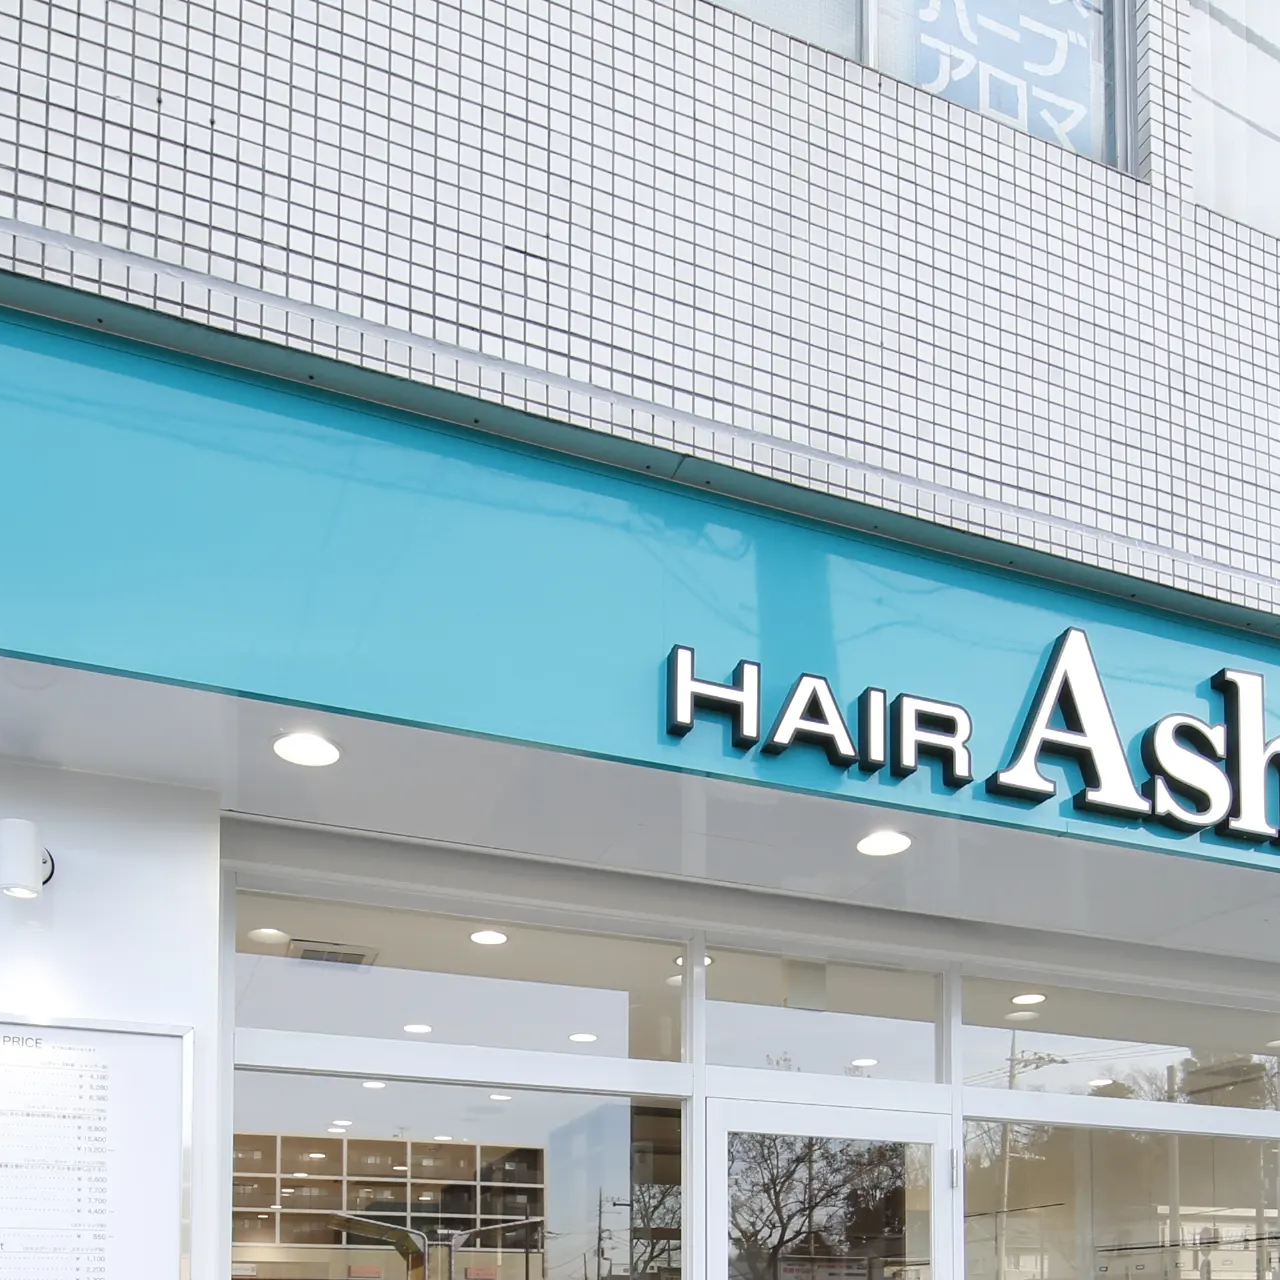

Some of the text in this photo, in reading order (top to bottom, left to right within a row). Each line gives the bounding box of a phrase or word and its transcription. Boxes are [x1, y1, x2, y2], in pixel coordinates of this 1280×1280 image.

[920, 33, 1088, 153] アロマ
[667, 643, 974, 786] HAIR
[3, 1035, 42, 1048] PRICE
